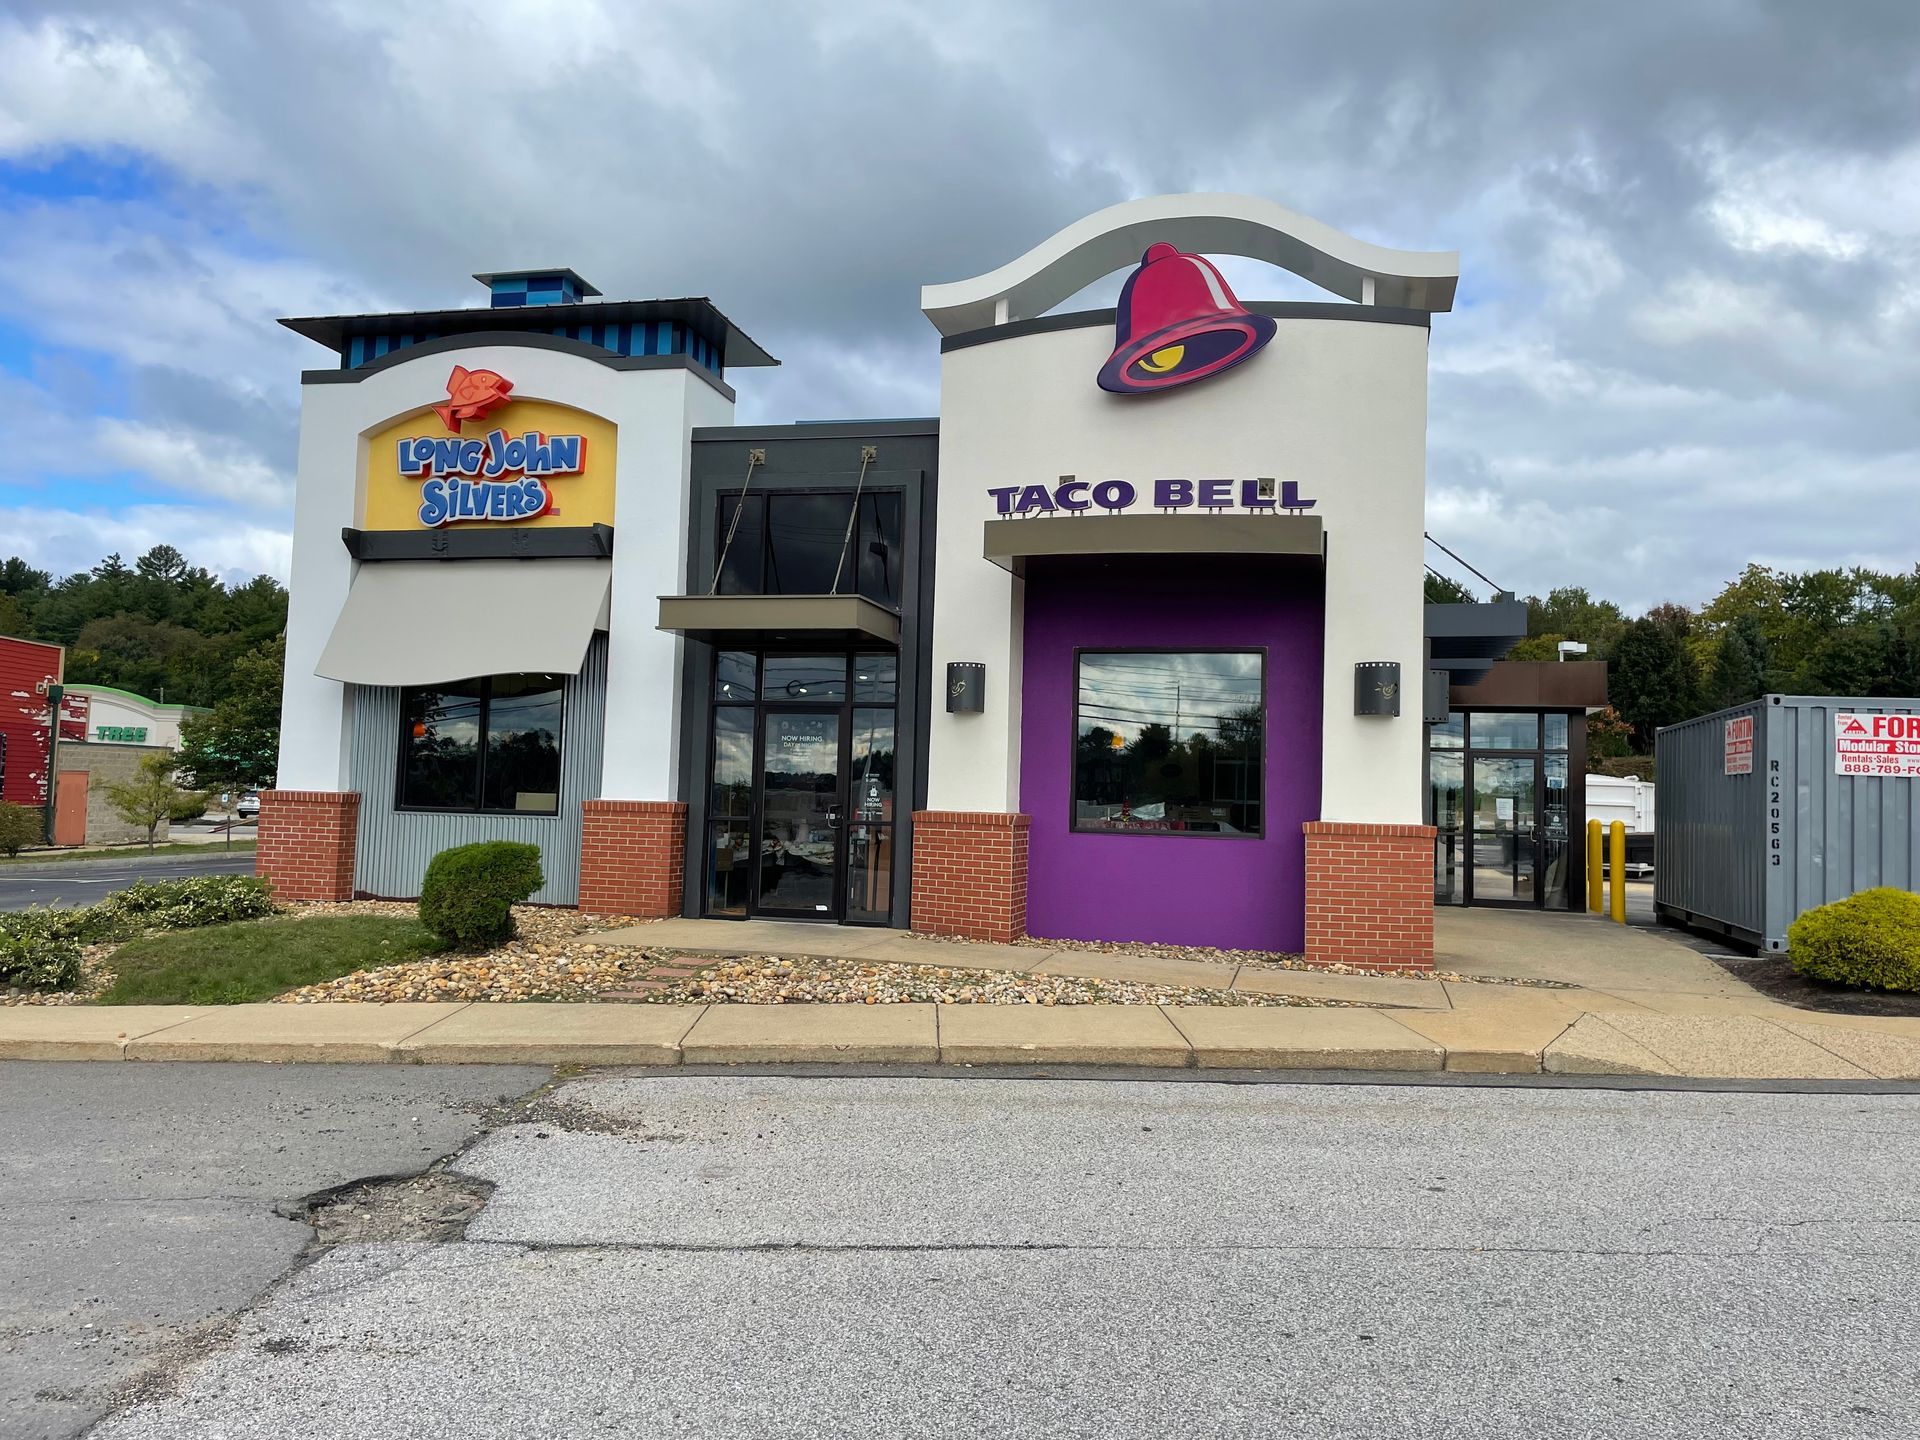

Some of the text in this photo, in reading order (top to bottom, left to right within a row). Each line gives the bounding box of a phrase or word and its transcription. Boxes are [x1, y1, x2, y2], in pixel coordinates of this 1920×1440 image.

[397, 436, 486, 476] LONG
[987, 479, 1318, 513] TACO BELL
[96, 726, 148, 742] TREE
[1839, 740, 1890, 752] Modular
[1770, 760, 1780, 866] RC20563
